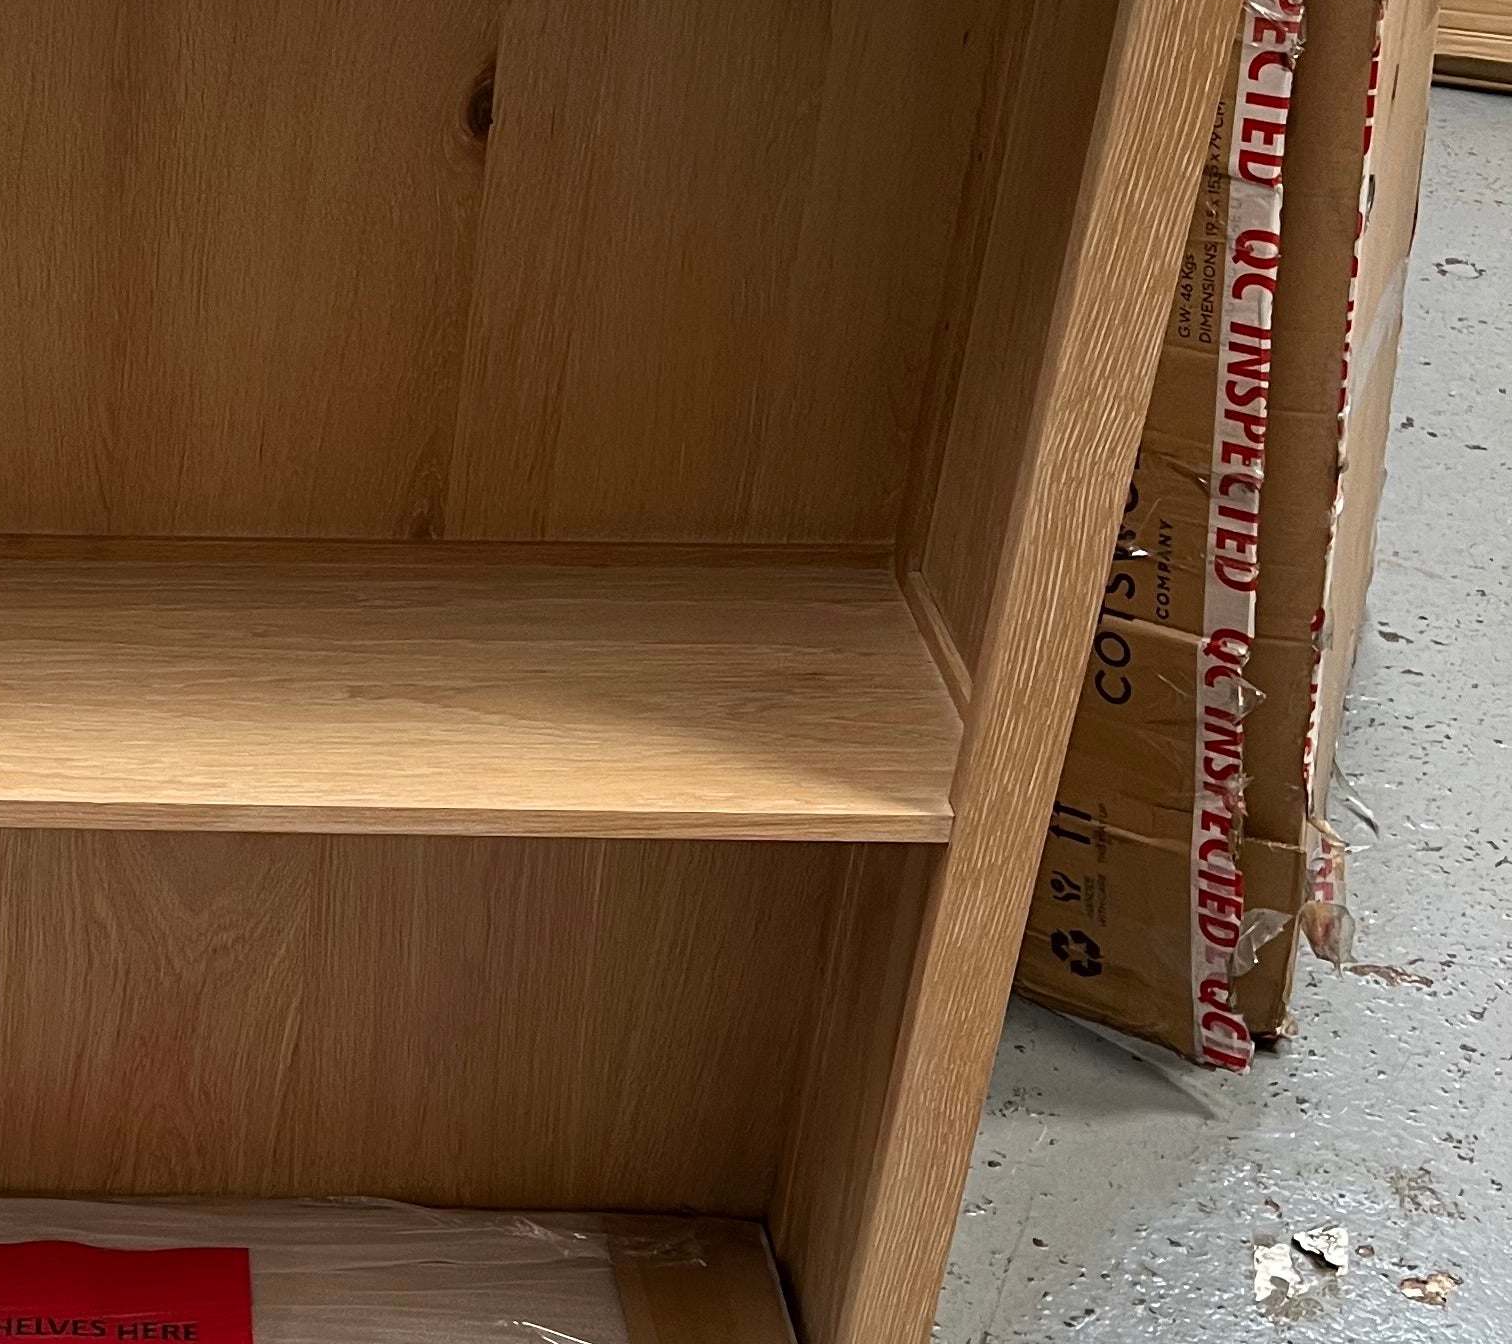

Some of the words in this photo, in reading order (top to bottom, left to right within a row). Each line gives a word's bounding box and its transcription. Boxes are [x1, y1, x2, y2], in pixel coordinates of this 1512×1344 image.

[1180, 283, 1193, 302] 46
[1232, 228, 1281, 302] QC
[1212, 320, 1273, 594] INSPECTED
[1156, 518, 1174, 621] COMPANY
[116, 1318, 202, 1343] HERE
